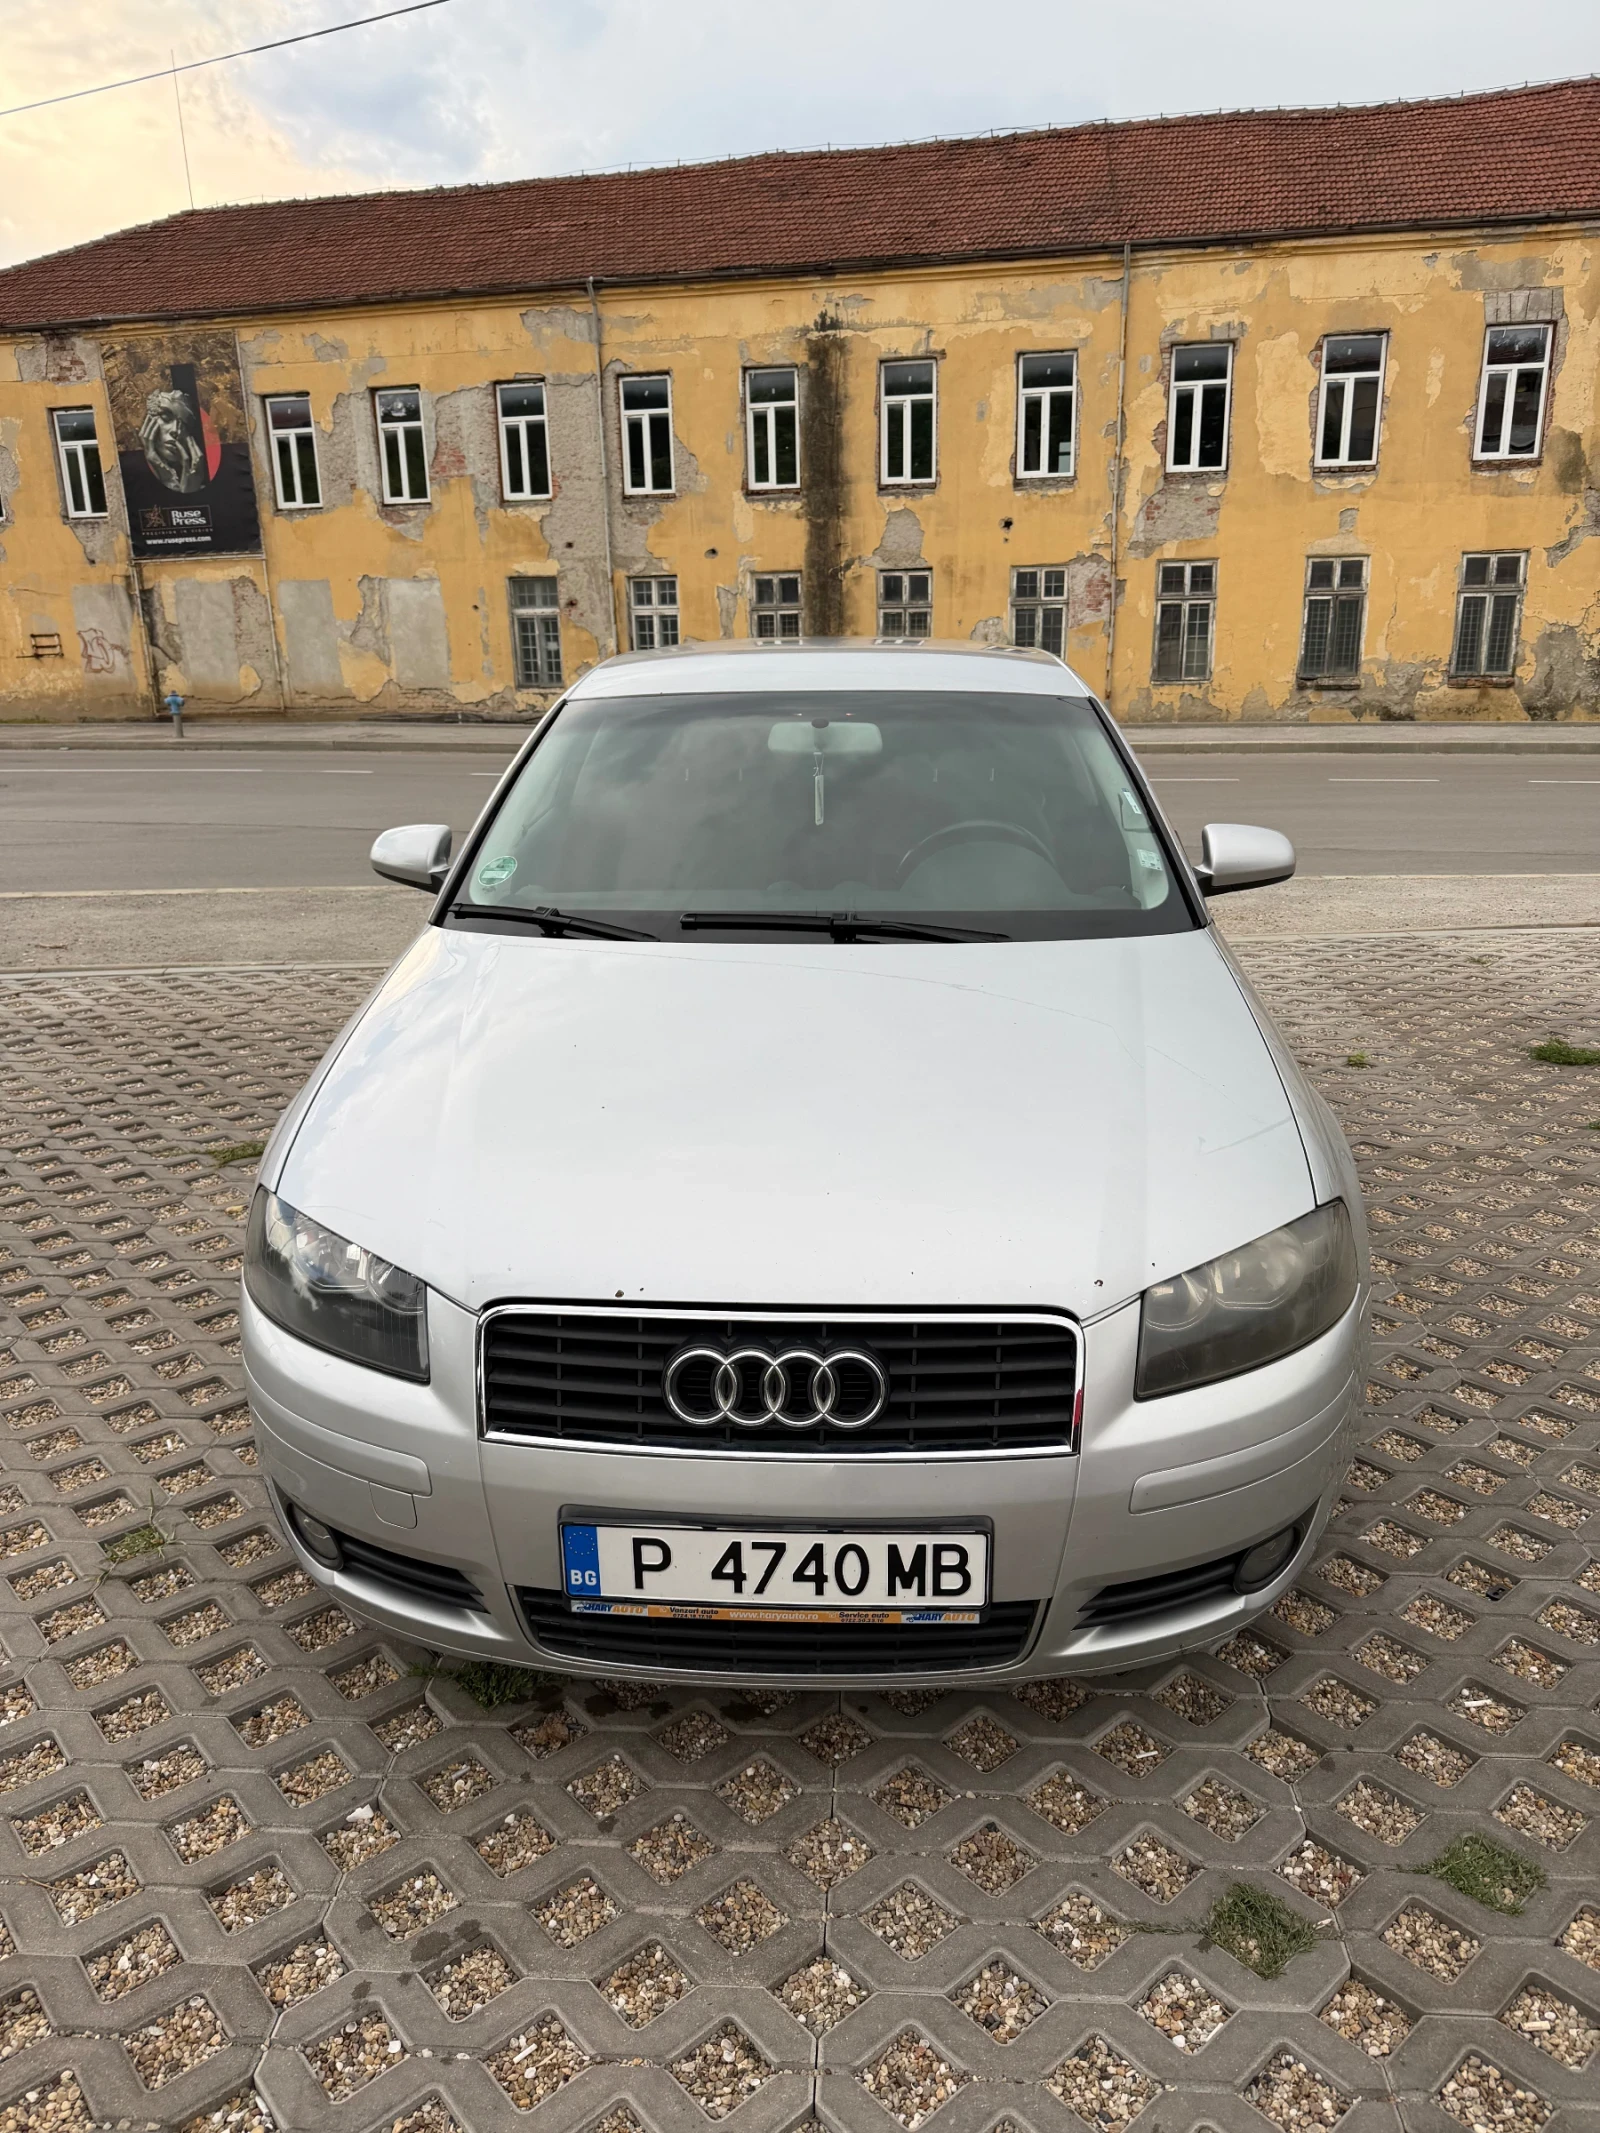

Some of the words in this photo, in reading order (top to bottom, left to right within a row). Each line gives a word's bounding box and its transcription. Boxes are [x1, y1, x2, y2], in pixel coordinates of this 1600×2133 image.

[171, 510, 201, 518] Ruse
[172, 517, 206, 525] Press
[146, 536, 212, 545] www.rusepress.com
[632, 1537, 671, 1590] P
[711, 1541, 870, 1596] 4740
[887, 1543, 971, 1597] MB
[570, 1569, 597, 1586] BG
[729, 1611, 818, 1621] www.haryauto.ro
